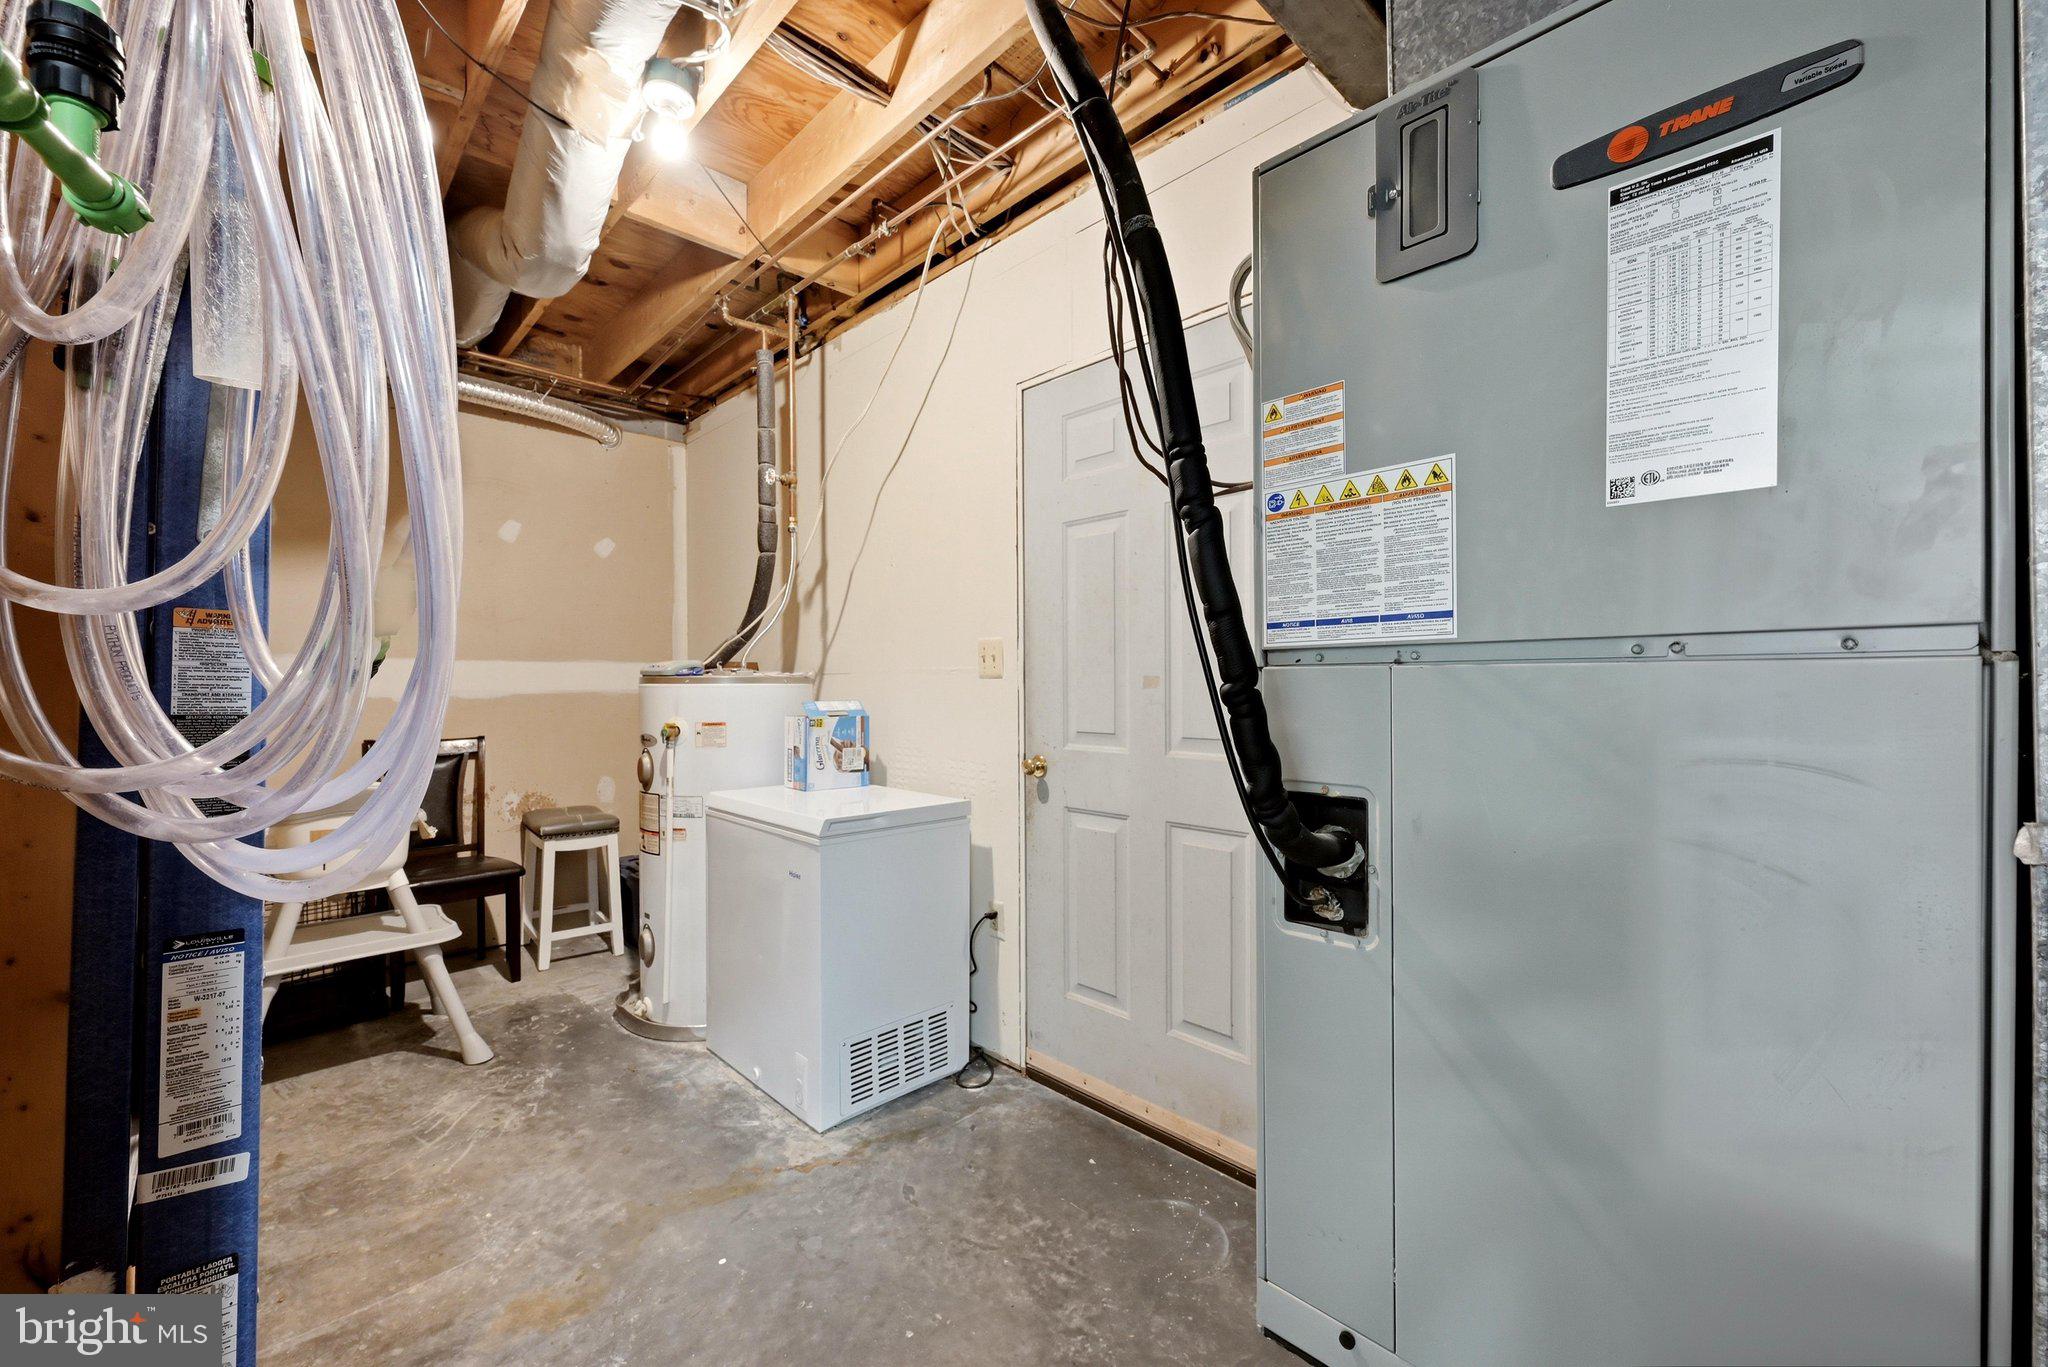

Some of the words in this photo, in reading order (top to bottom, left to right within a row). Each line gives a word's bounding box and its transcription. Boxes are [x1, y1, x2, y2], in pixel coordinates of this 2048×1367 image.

[1794, 70, 1822, 85] Variable
[1824, 60, 1848, 74] Speed
[1659, 96, 1735, 138] TRANE
[104, 625, 124, 658] PYTHON
[115, 660, 144, 701] PRODUCTS
[186, 935, 234, 945] LOUISVILLE
[171, 950, 204, 961] NOTICE
[210, 946, 235, 955] AVISO
[161, 1266, 201, 1286] PORTABLE
[202, 1256, 233, 1271] LADDER
[165, 1281, 199, 1294] CHELLE
[200, 1270, 229, 1286] MOBILE
[157, 1275, 198, 1293] ESCALERA
